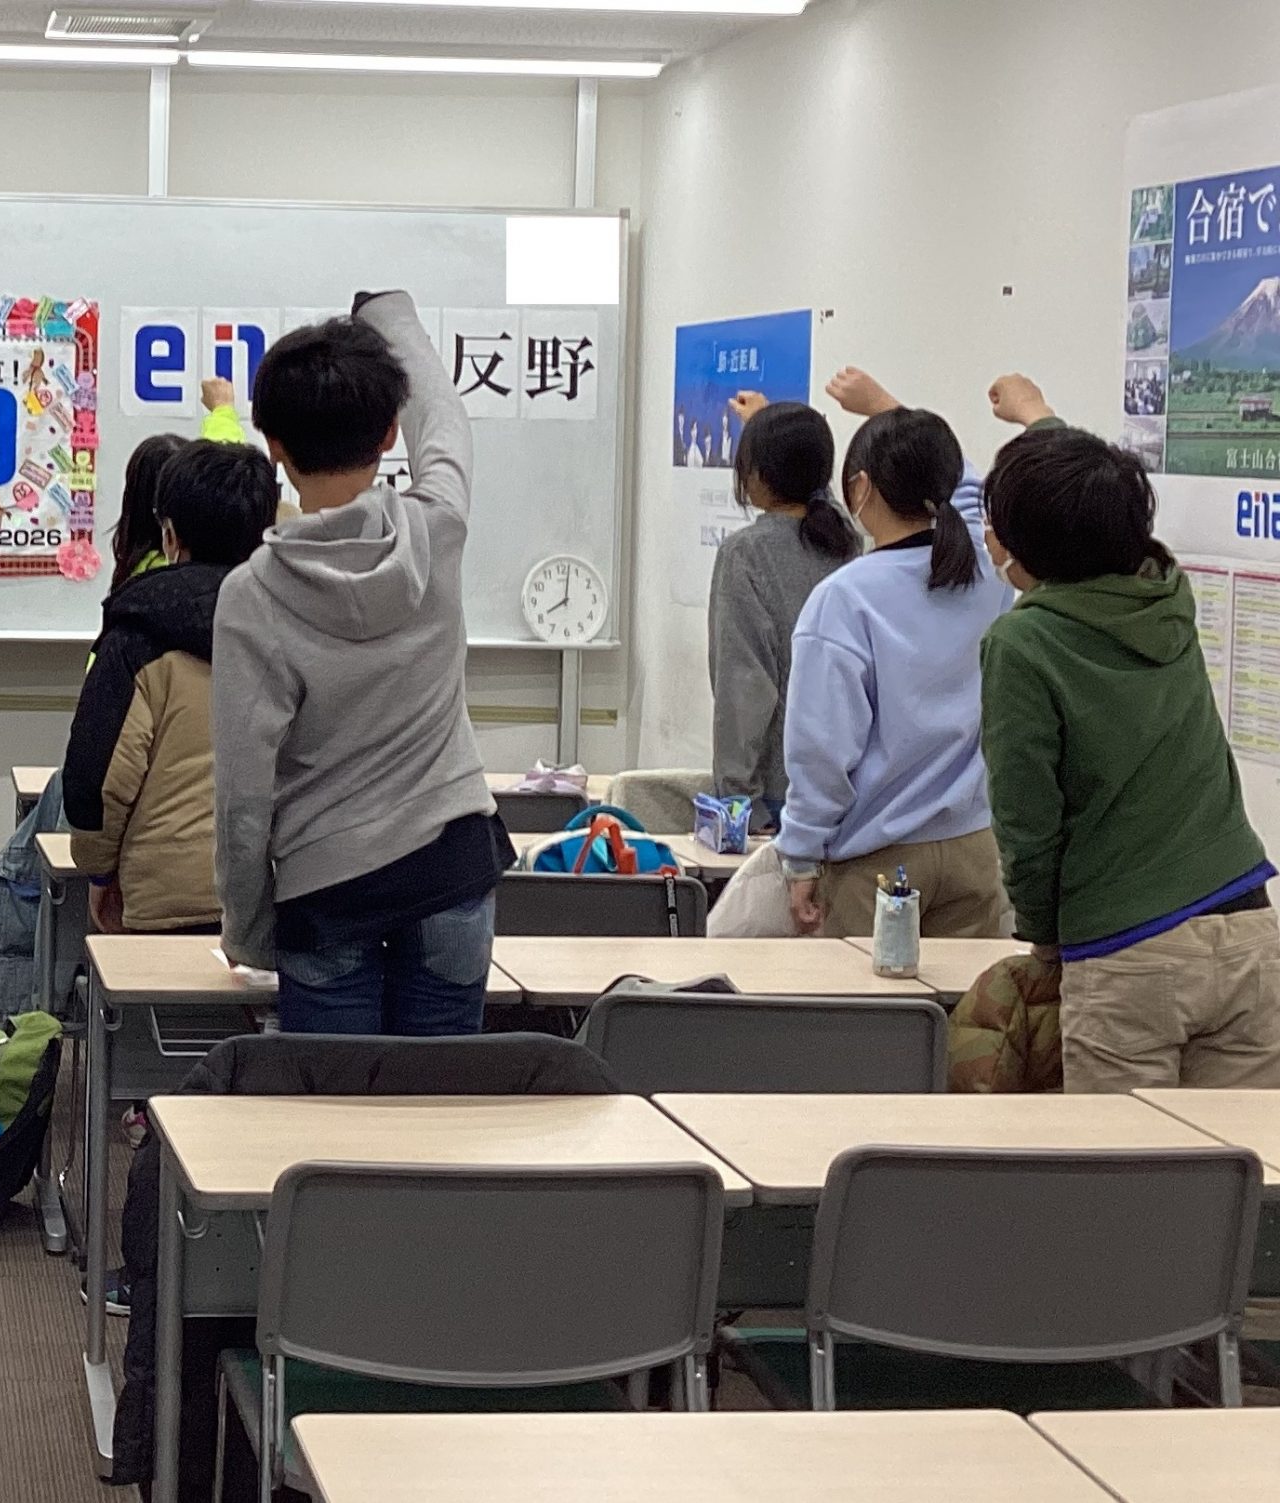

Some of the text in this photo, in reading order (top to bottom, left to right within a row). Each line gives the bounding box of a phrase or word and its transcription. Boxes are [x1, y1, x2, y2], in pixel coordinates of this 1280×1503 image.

[1186, 182, 1277, 245] 合宿で
[1226, 447, 1280, 471] 富士山合
